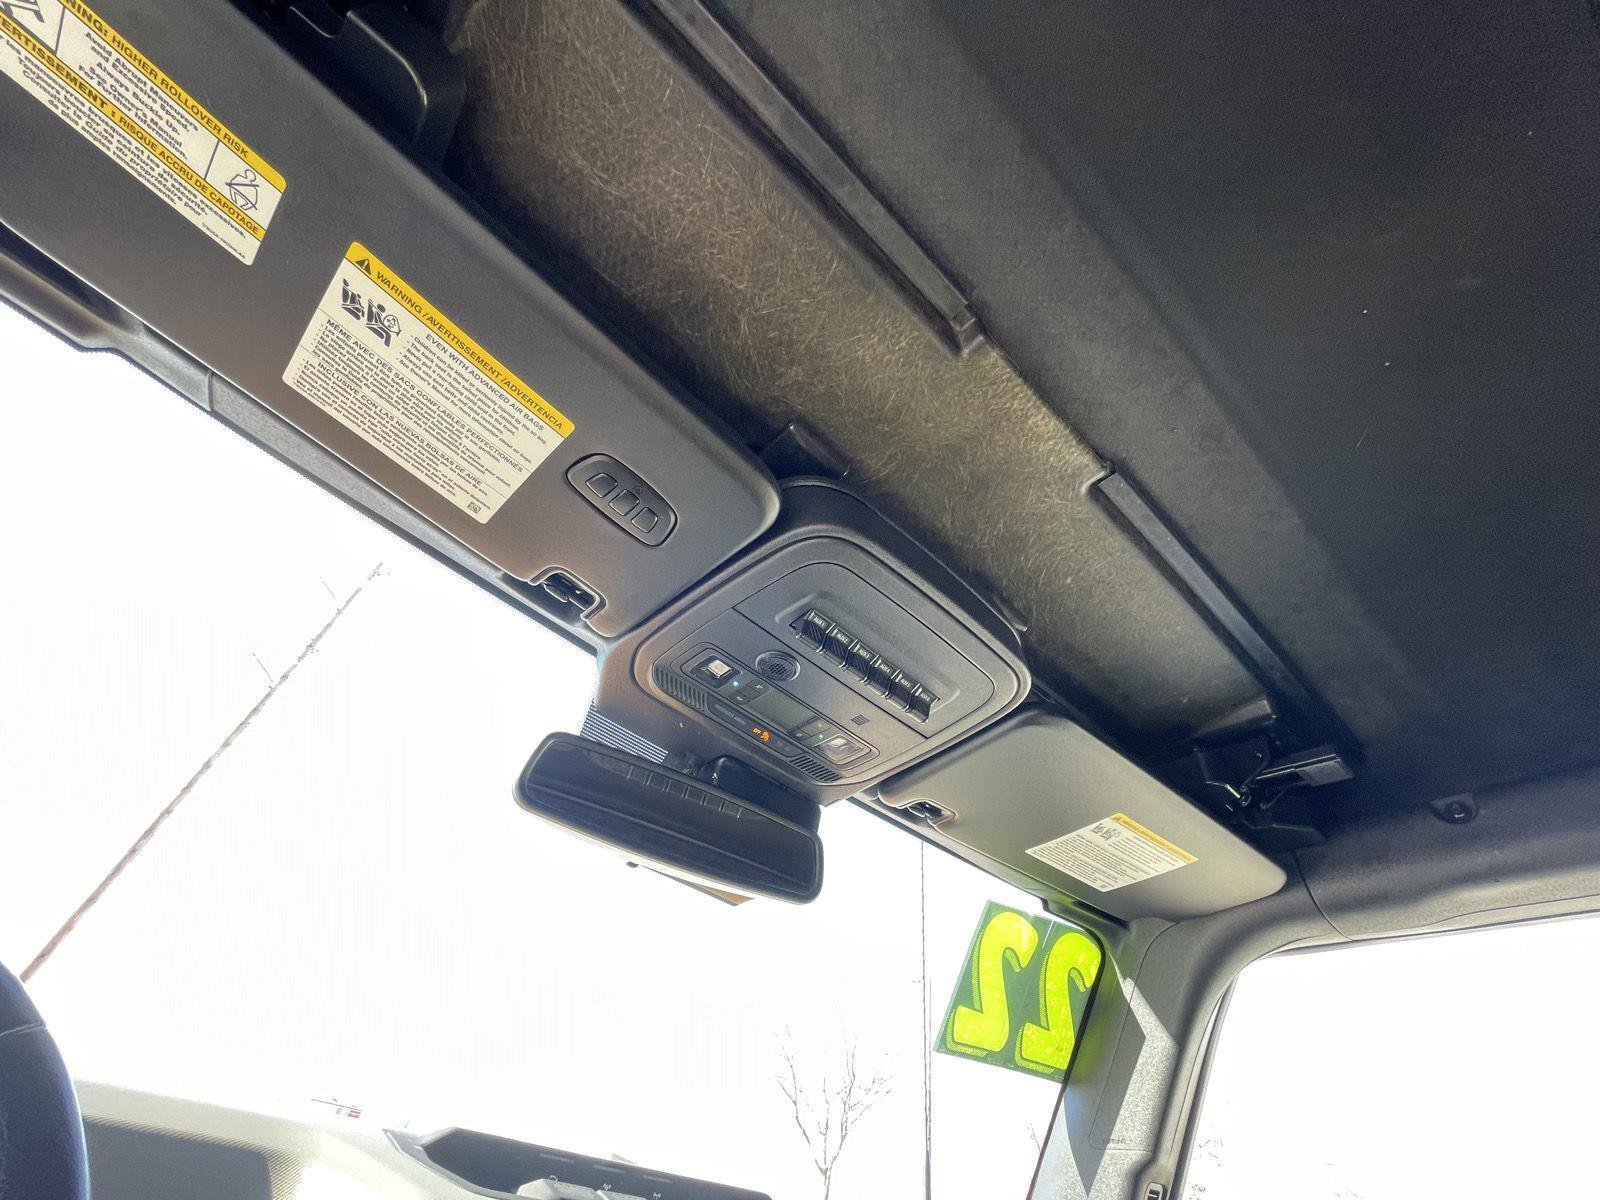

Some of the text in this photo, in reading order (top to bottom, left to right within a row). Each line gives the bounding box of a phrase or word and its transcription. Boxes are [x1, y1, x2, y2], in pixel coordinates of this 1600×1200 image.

[0, 15, 107, 110] ERTISSEMENT
[118, 115, 157, 153] RISQUE
[158, 148, 193, 181] ACCRU
[194, 177, 208, 194] DE
[209, 190, 259, 235] CAPOTAGE
[6, 38, 21, 56] les
[87, 105, 132, 146] brusques
[134, 144, 144, 155] et
[146, 154, 160, 169] les
[17, 57, 60, 97] Toujours
[62, 93, 101, 129] boucler
[103, 126, 114, 139] sa
[47, 97, 58, 110] de
[60, 107, 79, 126] plus
[80, 123, 111, 152] amples
[77, 64, 188, 160] For Further Information.
[85, 29, 198, 132] Avoid Abrupt Maneuvers
[88, 65, 182, 148] See Owner's Manual
[90, 42, 190, 133] and Excessive Speed.
[96, 59, 180, 137] Always Buckle Up.
[111, 33, 158, 81] HIGHER
[160, 75, 221, 136] ROLLOVER
[222, 131, 248, 158] RISK
[22, 68, 71, 112] Consulter
[73, 109, 83, 121] le
[84, 119, 113, 146] Guide
[115, 143, 127, 157] du
[184, 200, 201, 217] pour
[375, 271, 423, 314] WARNING
[325, 318, 352, 342] MÊME
[352, 339, 375, 360] AVEC
[375, 357, 393, 373] DES
[393, 370, 416, 391] SACS
[415, 388, 466, 429] GONFLABLES
[465, 427, 523, 473] PERFECTIONNÉS
[402, 353, 422, 371] Always
[421, 369, 432, 379] use
[431, 377, 445, 389] seat
[446, 388, 458, 399] belts
[456, 396, 468, 407] and
[466, 404, 480, 417] child
[405, 348, 422, 363] Never
[421, 360, 432, 371] put
[476, 404, 488, 415] seat
[493, 417, 502, 426] the
[409, 342, 421, 353] The
[420, 351, 435, 364] back
[434, 362, 447, 374] seat
[452, 376, 461, 385] the
[476, 396, 491, 409] place
[490, 407, 499, 416] for
[413, 336, 437, 357] Children
[435, 354, 447, 365] can
[446, 363, 454, 371] be
[453, 369, 469, 383] killed
[425, 333, 544, 431] EVEN WITH ADVANCED AIR BAGS
[317, 362, 359, 395] INCLUSIVE
[360, 394, 378, 409] CON
[378, 407, 394, 421] LAS
[394, 419, 425, 444] NUEVAS
[425, 442, 455, 466] BOLSAS
[454, 464, 465, 473] DE
[464, 471, 482, 486] AIRE
[398, 359, 410, 369] See
[409, 367, 431, 386] Owner's
[430, 384, 450, 401] Manual
[449, 399, 459, 408] for
[457, 405, 472, 418] more
[497, 437, 512, 449] about
[511, 447, 519, 455] air
